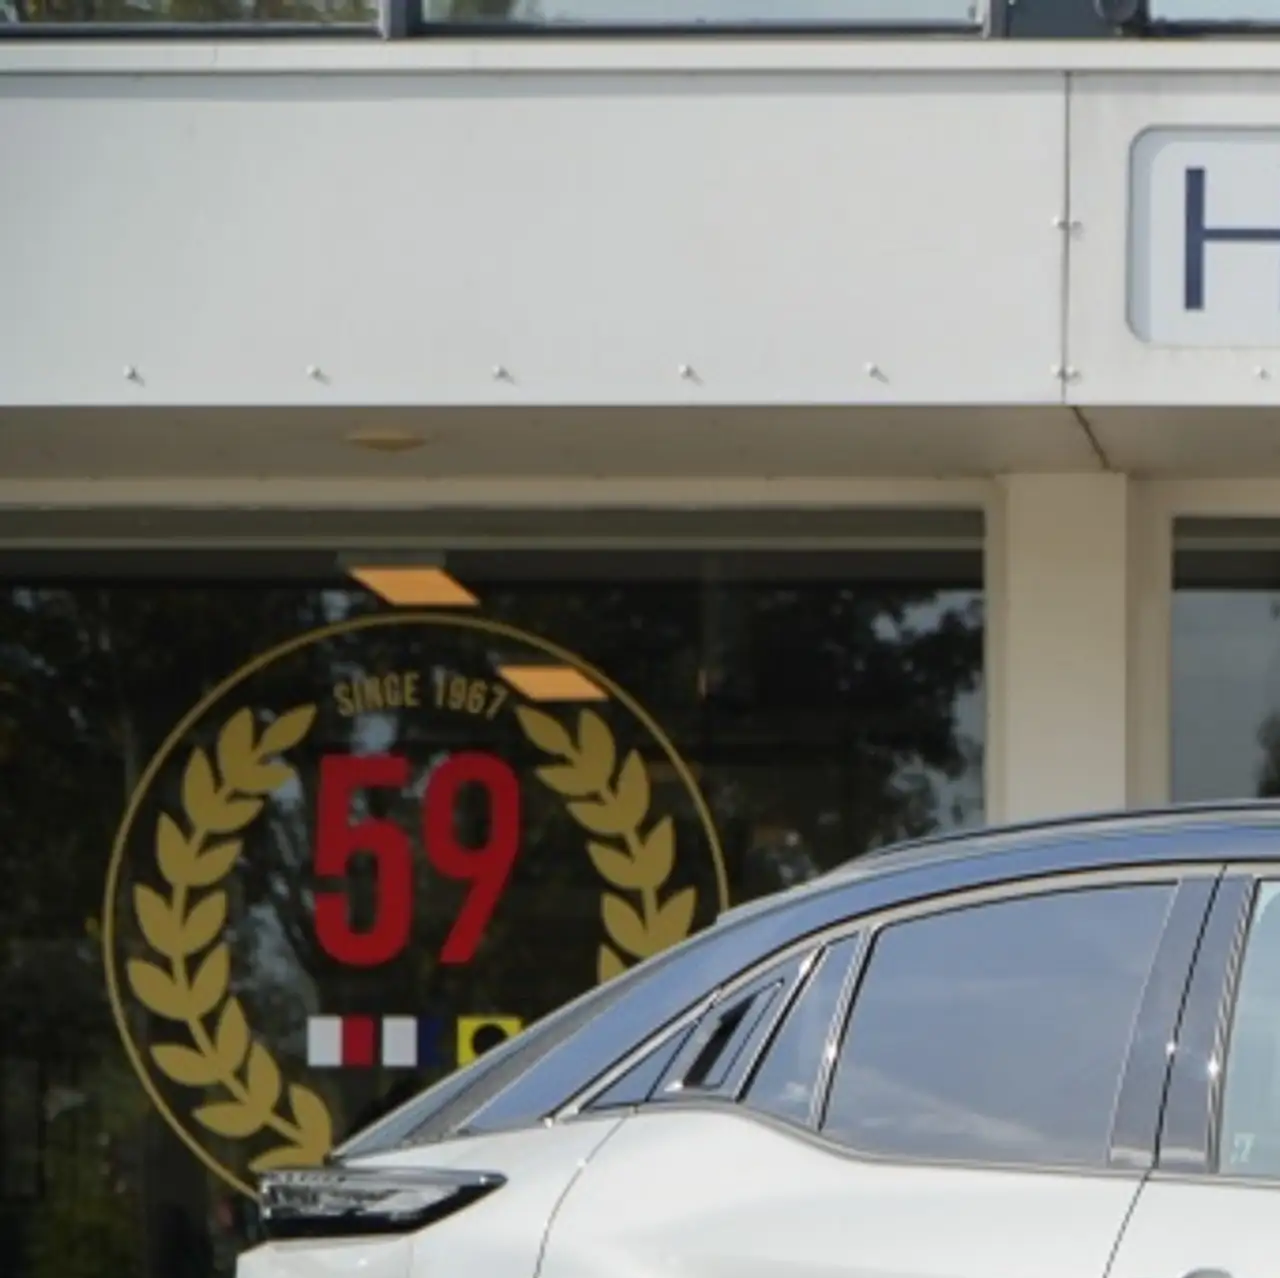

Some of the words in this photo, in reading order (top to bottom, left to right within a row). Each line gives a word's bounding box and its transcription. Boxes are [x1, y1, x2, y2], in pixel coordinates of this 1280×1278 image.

[332, 671, 421, 718] SINCE
[432, 664, 509, 721] 1967
[313, 751, 521, 967] 59
